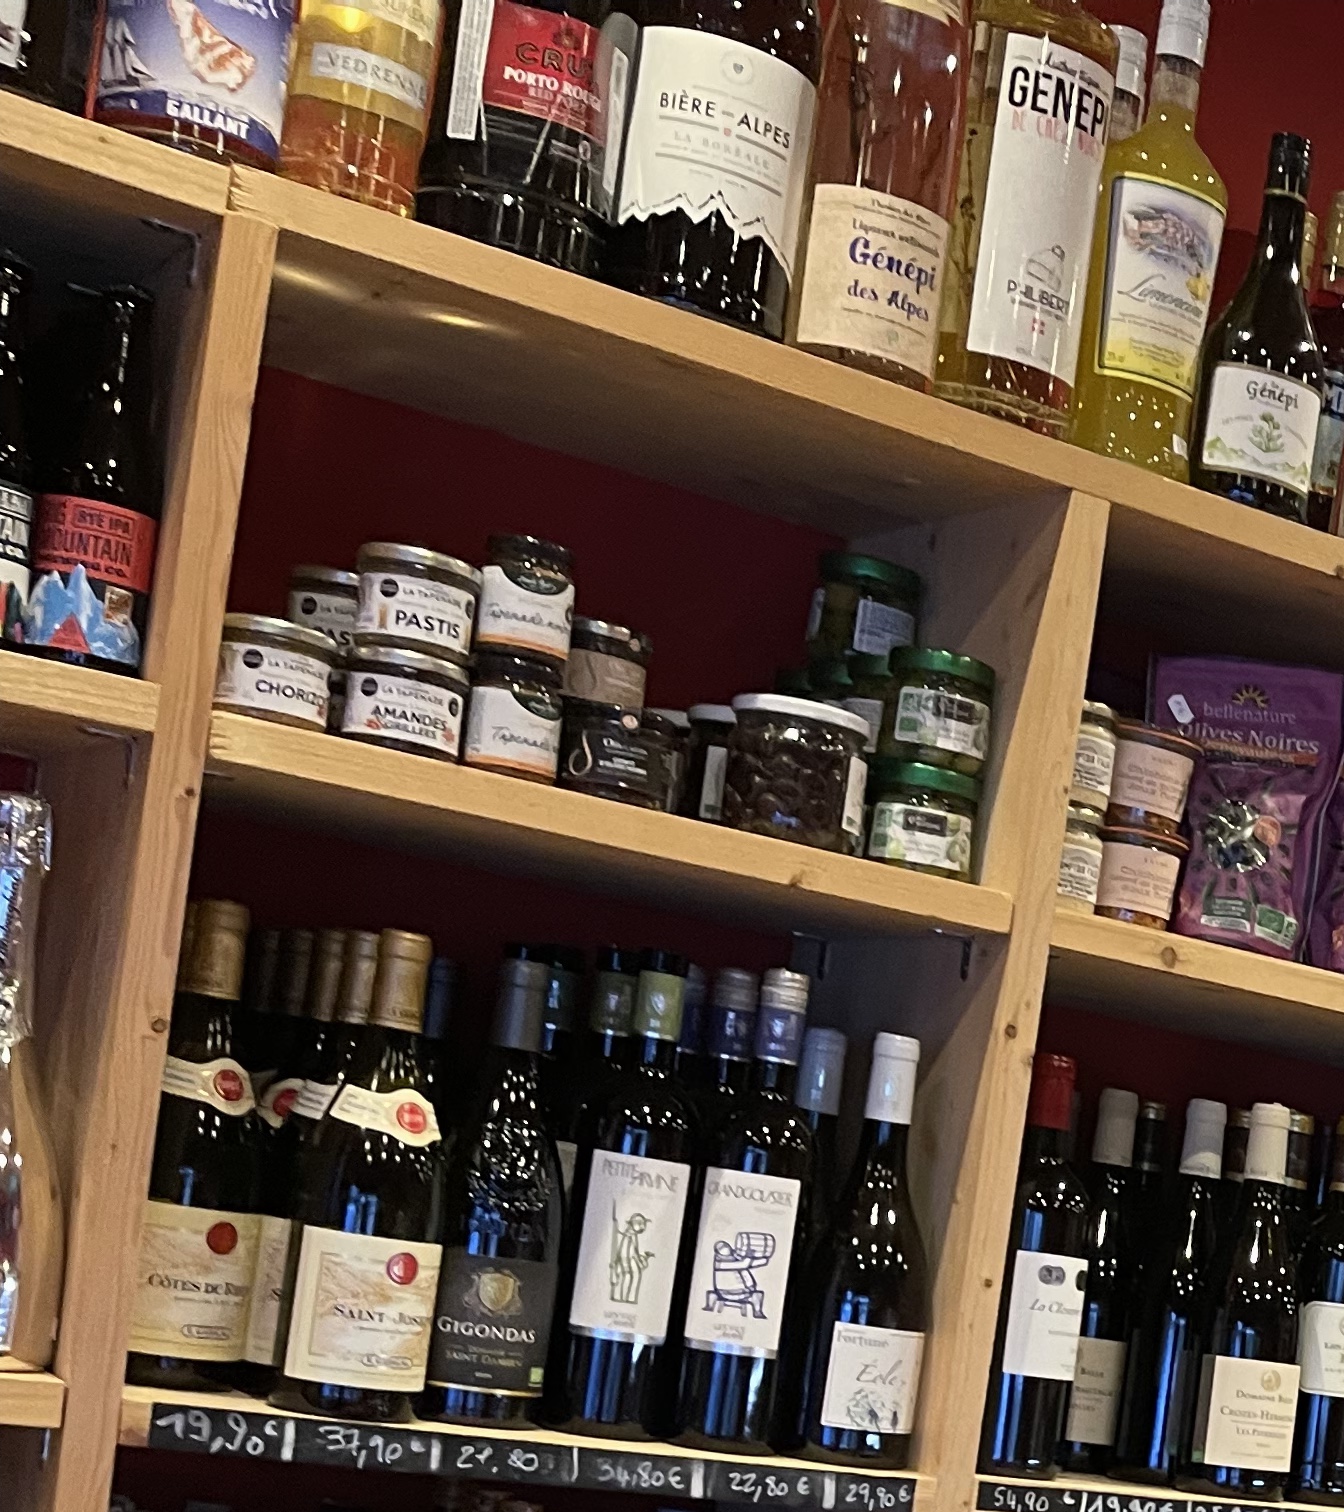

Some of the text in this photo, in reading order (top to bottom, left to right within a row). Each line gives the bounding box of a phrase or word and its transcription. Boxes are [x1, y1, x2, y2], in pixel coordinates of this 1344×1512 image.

[515, 42, 593, 79] CRU
[503, 65, 557, 92] PORTO
[659, 89, 717, 118] BIÈRE
[736, 112, 791, 150] ALPES
[849, 236, 937, 295] Génépi
[847, 279, 930, 323] des Alpes
[395, 609, 461, 640] PASTIS
[371, 705, 449, 731] AMANDES
[1203, 701, 1297, 726] bellenature
[1247, 730, 1320, 755] Noires
[437, 1315, 536, 1344] GIGONDAS
